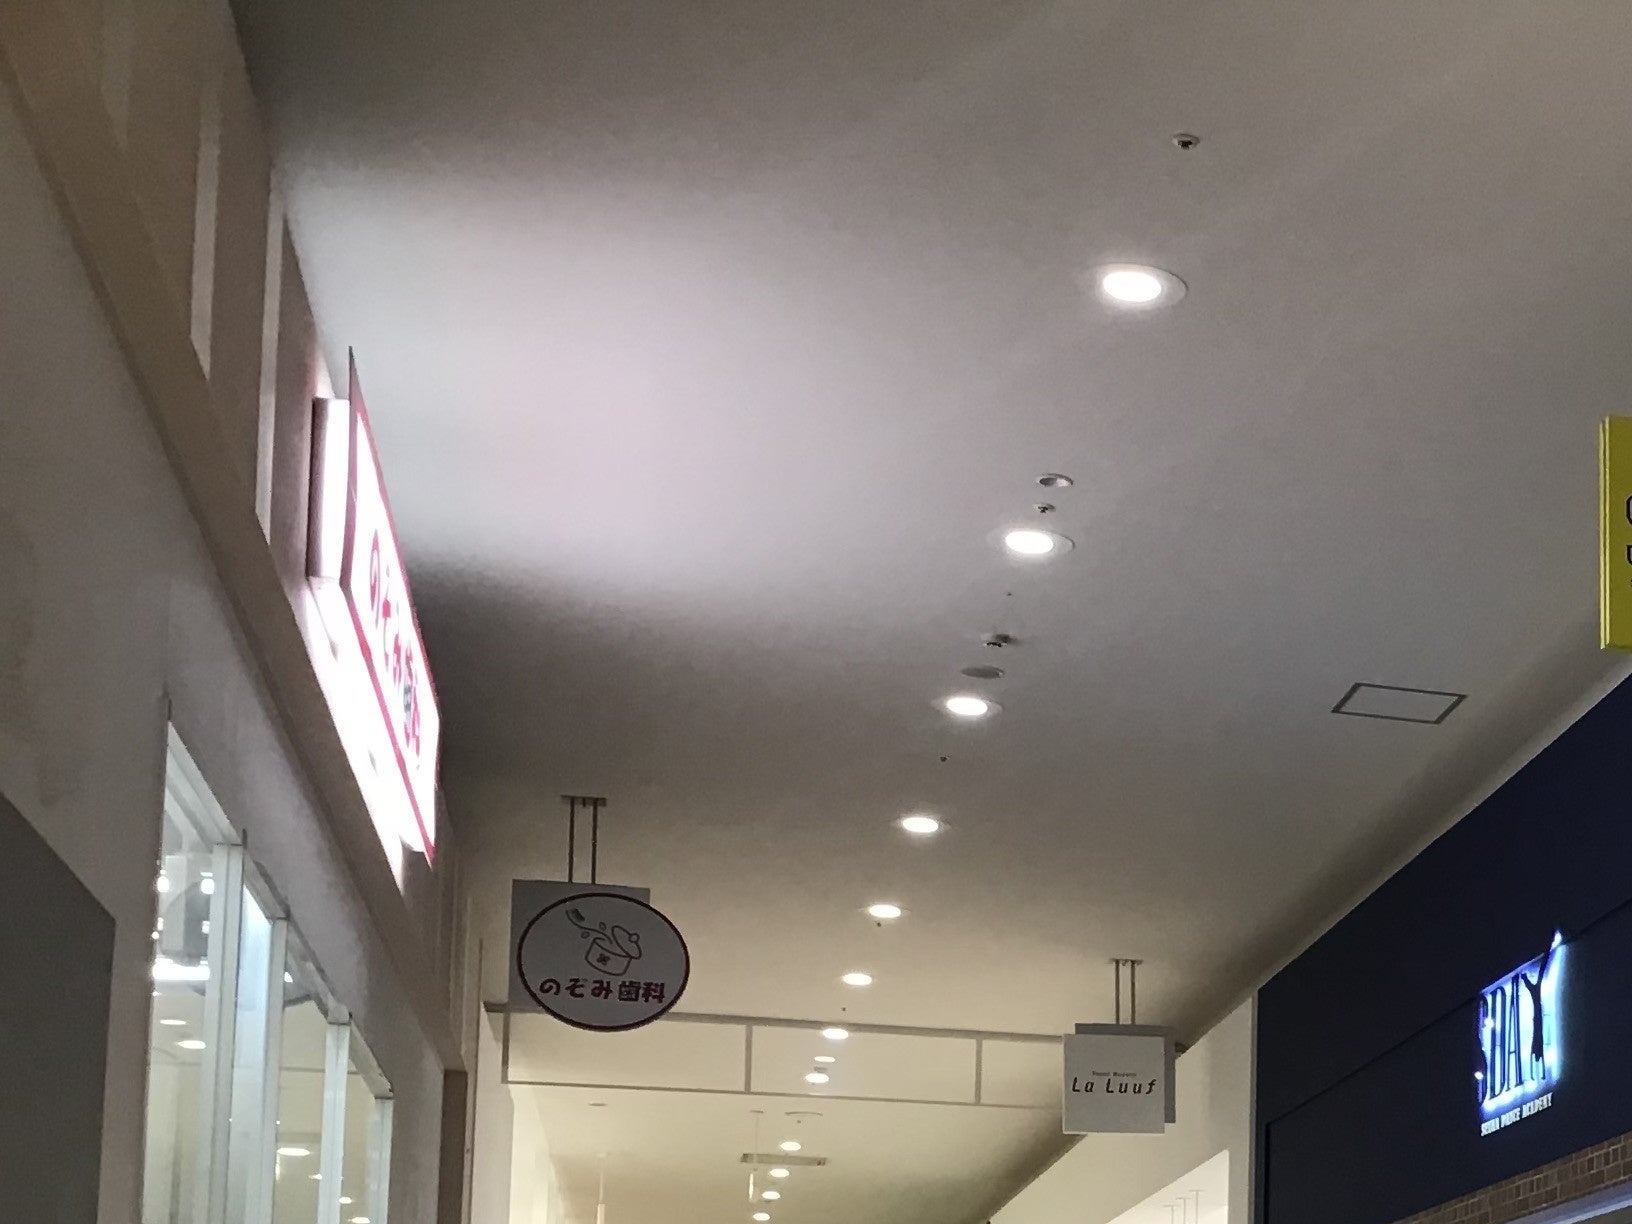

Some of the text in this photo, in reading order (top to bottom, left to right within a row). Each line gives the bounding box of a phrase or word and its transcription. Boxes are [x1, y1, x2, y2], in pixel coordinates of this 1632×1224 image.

[539, 977, 666, 1004] のぞみ歯科
[1071, 1077, 1095, 1093] La
